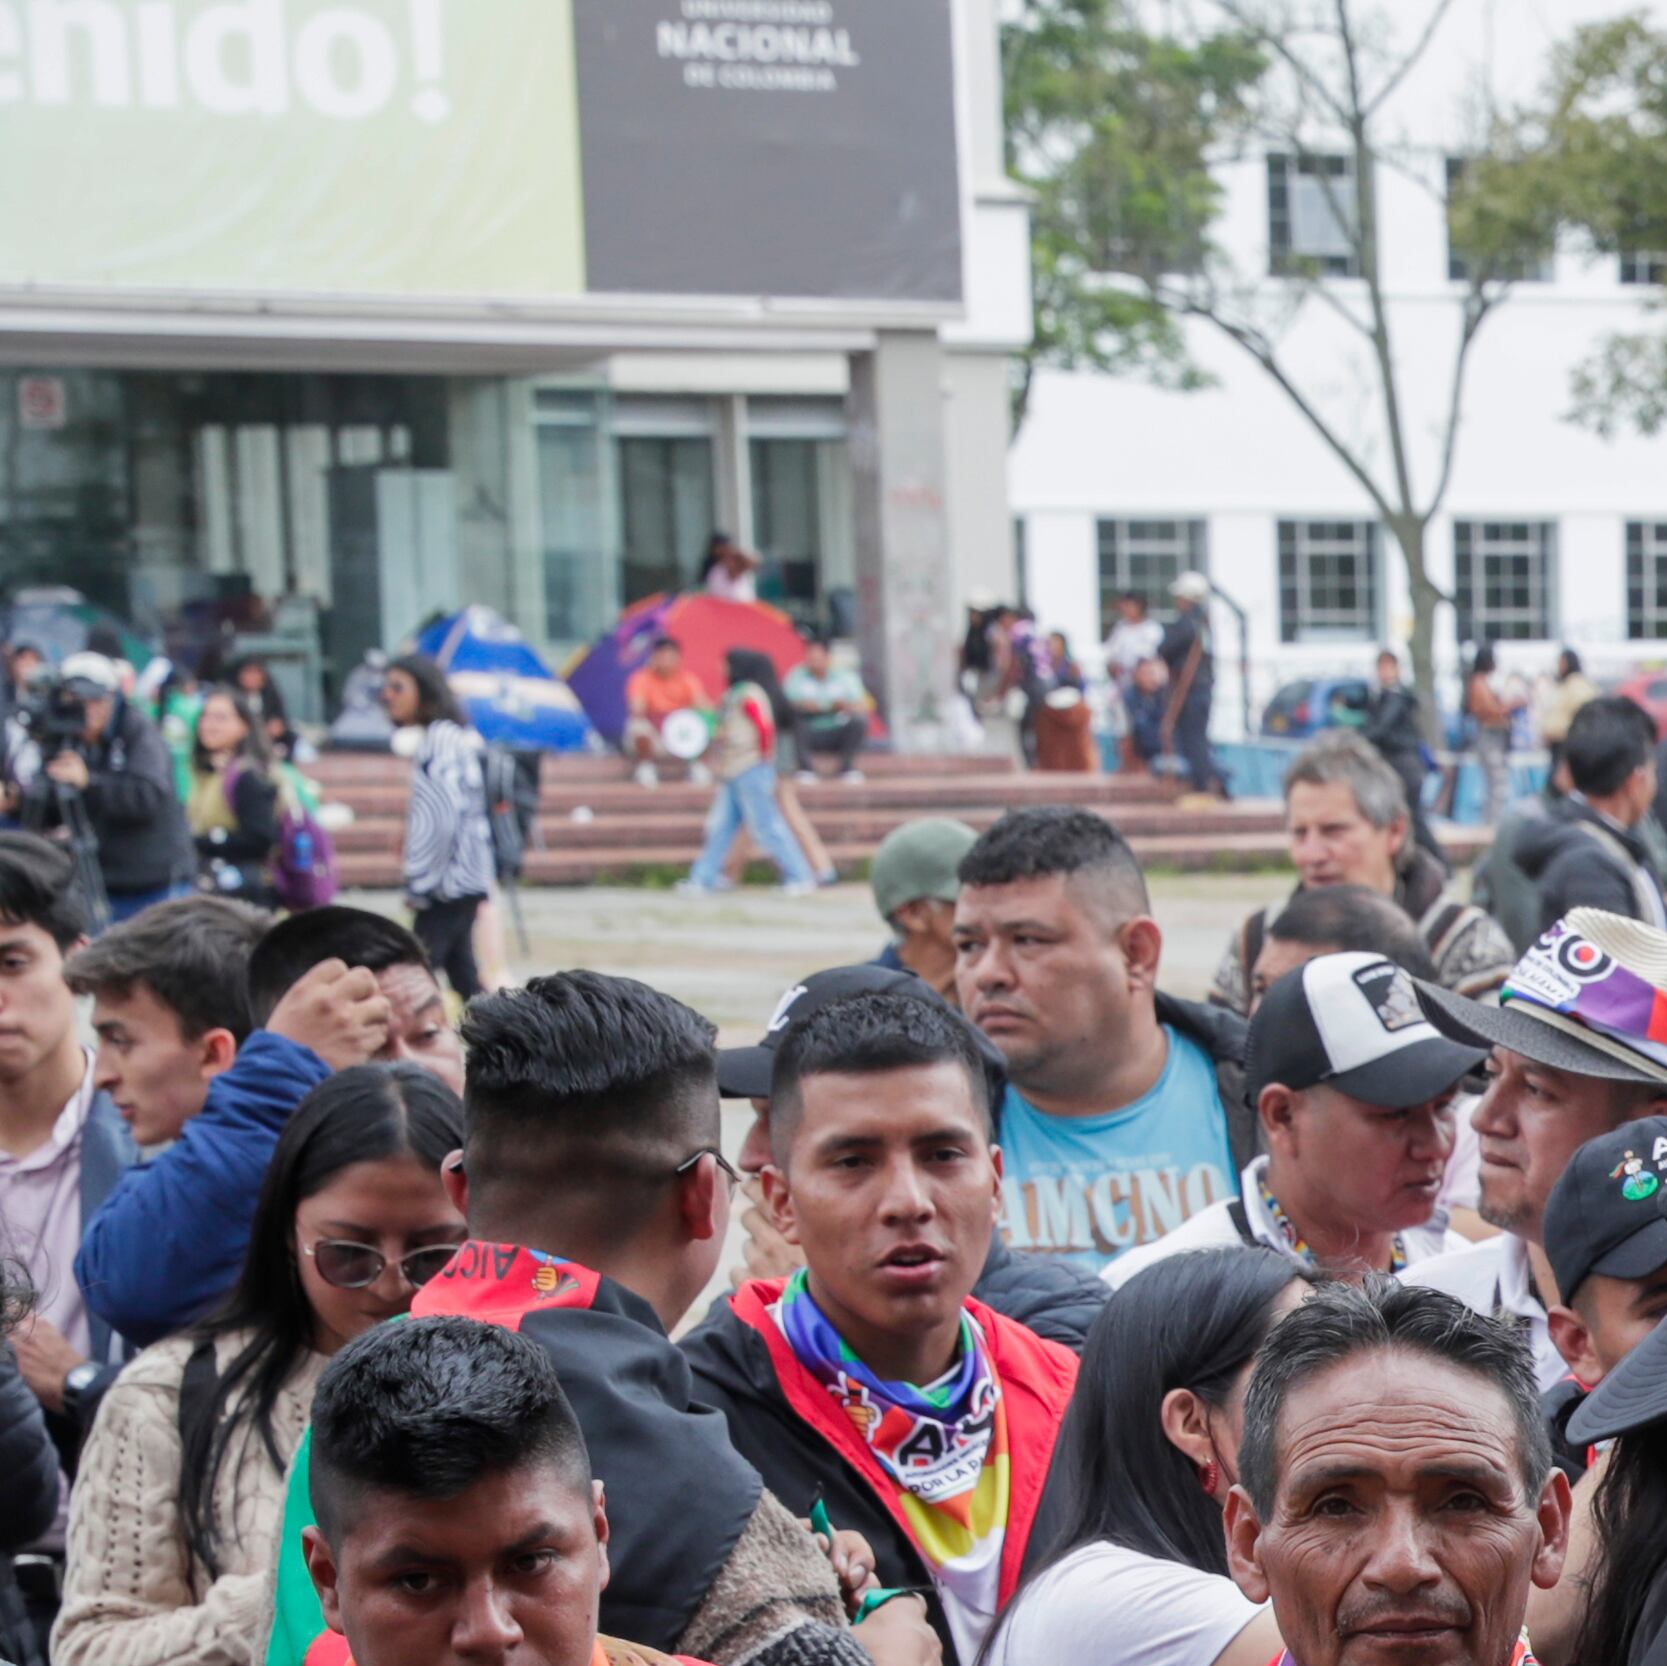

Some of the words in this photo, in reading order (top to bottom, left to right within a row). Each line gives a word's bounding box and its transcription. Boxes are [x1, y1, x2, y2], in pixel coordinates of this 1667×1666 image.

[0, 0, 450, 124] nido!
[656, 19, 861, 67] NACIONAL
[717, 62, 838, 92] COLOMBIA
